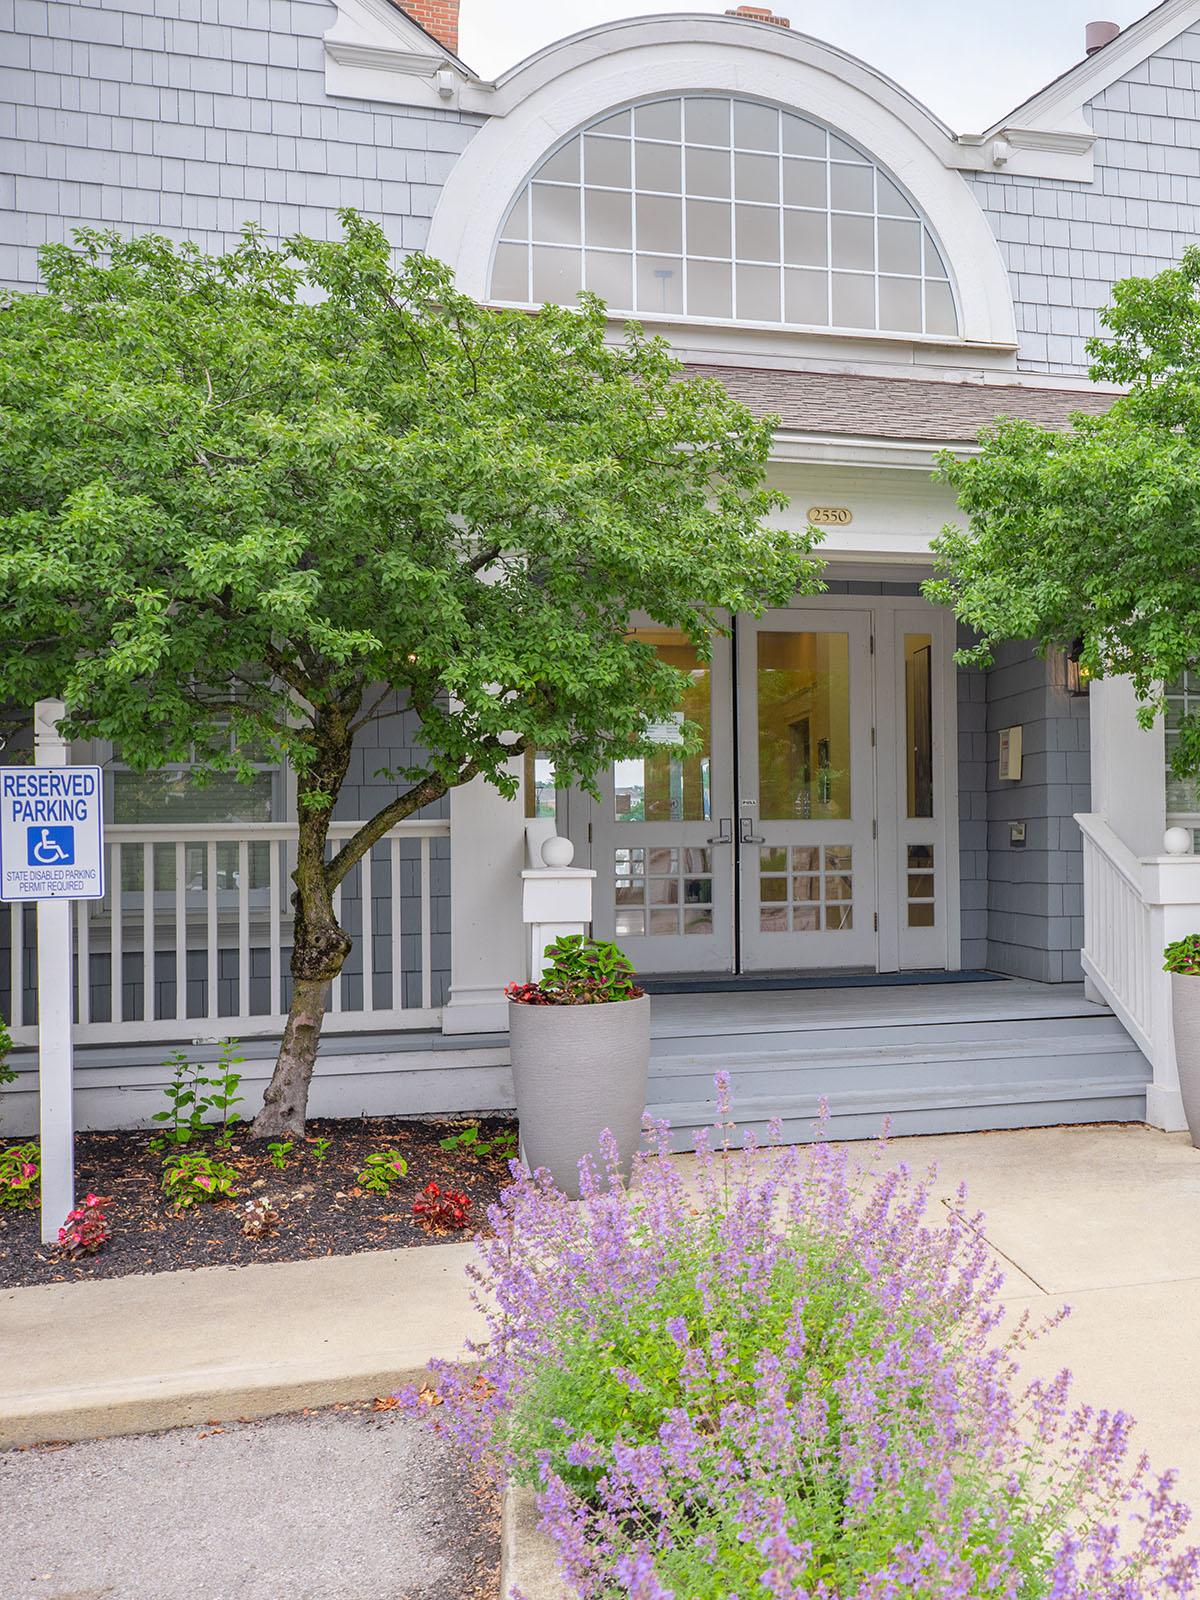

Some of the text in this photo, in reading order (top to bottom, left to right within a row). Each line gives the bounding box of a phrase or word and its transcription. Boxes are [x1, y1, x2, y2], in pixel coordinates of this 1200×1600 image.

[814, 509, 847, 522] 2550
[4, 774, 95, 797] RESERVED
[12, 799, 88, 822] PARKING
[7, 869, 96, 881] STATE DISABLED PARKING
[20, 880, 84, 892] PERMIT REQUIRED
